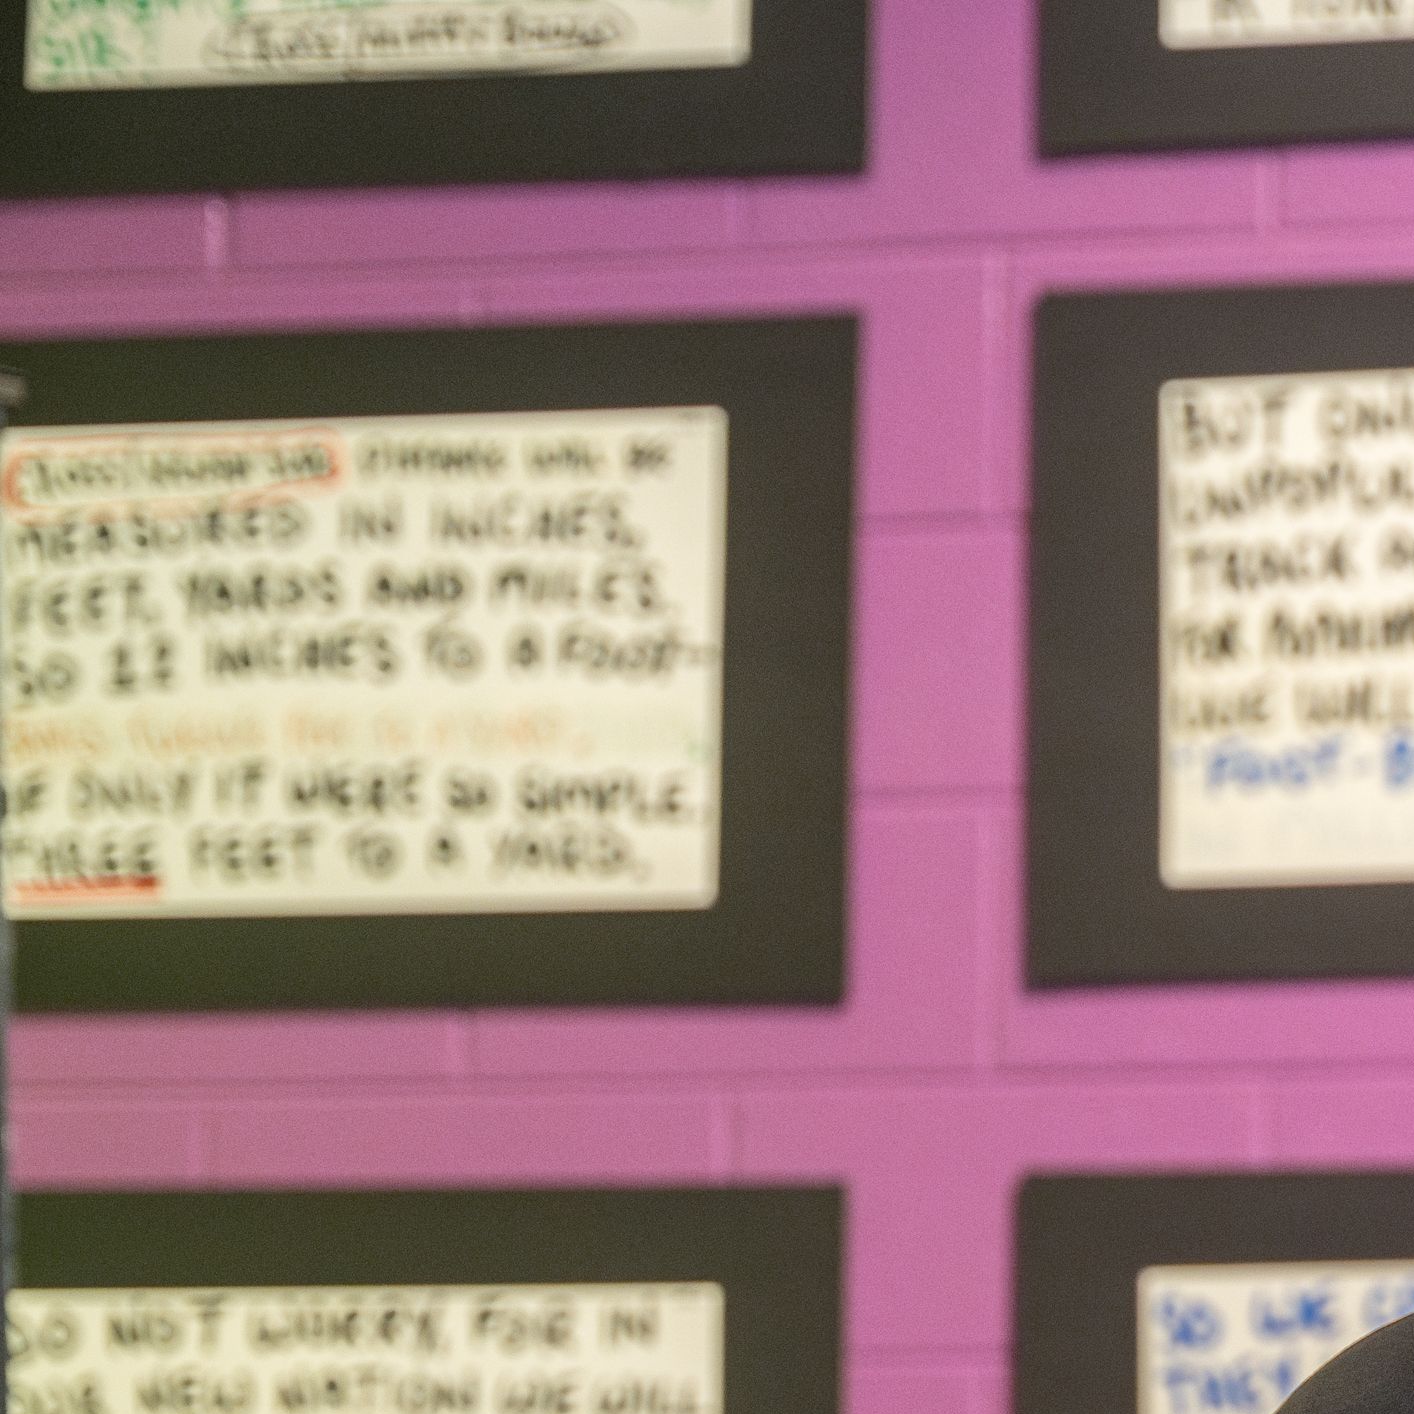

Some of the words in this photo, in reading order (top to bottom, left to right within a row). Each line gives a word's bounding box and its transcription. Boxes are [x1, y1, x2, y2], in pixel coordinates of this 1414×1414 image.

[338, 499, 401, 543] IN
[363, 561, 472, 612] AND
[207, 624, 396, 690] INCHES
[422, 617, 486, 680] TO
[511, 624, 542, 672] A
[72, 766, 192, 820] ONLY
[214, 760, 263, 816] IT
[286, 757, 422, 820] WERE
[193, 822, 318, 882] FEET
[344, 831, 402, 885] TO
[427, 828, 461, 876] A
[105, 1304, 229, 1359] NOT
[600, 1308, 660, 1352] IN
